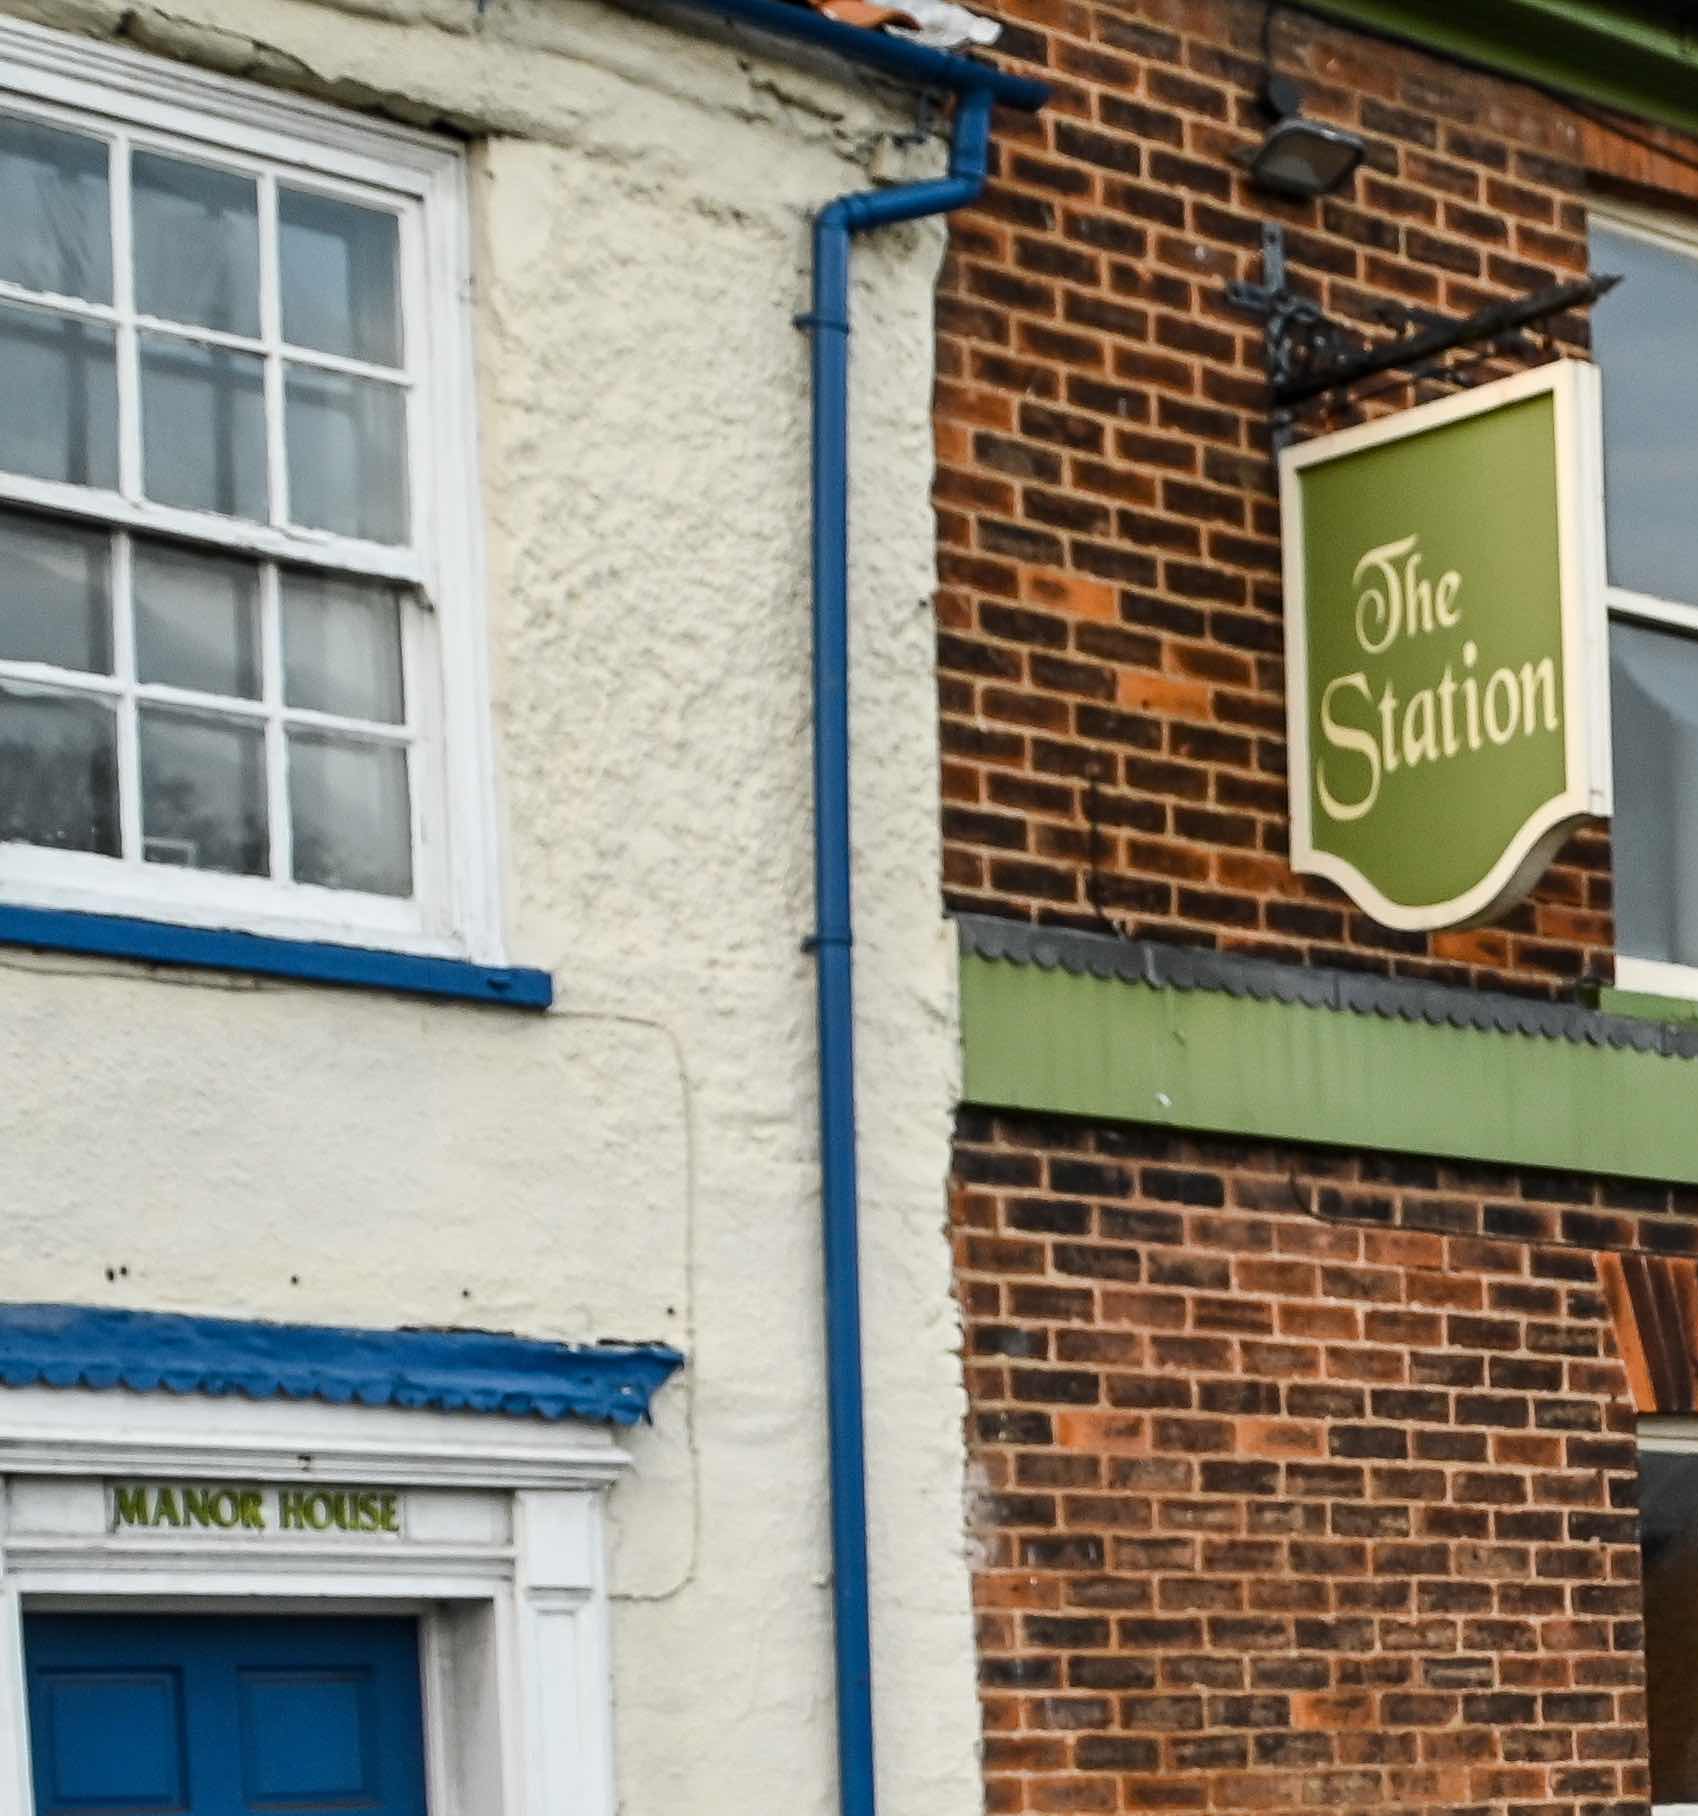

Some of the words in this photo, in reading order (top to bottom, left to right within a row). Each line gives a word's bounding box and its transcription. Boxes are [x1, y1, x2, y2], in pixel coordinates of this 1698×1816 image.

[1352, 532, 1462, 655] The
[1316, 639, 1559, 822] Station
[113, 1486, 266, 1530] MANOR
[277, 1488, 400, 1532] HOUSE
